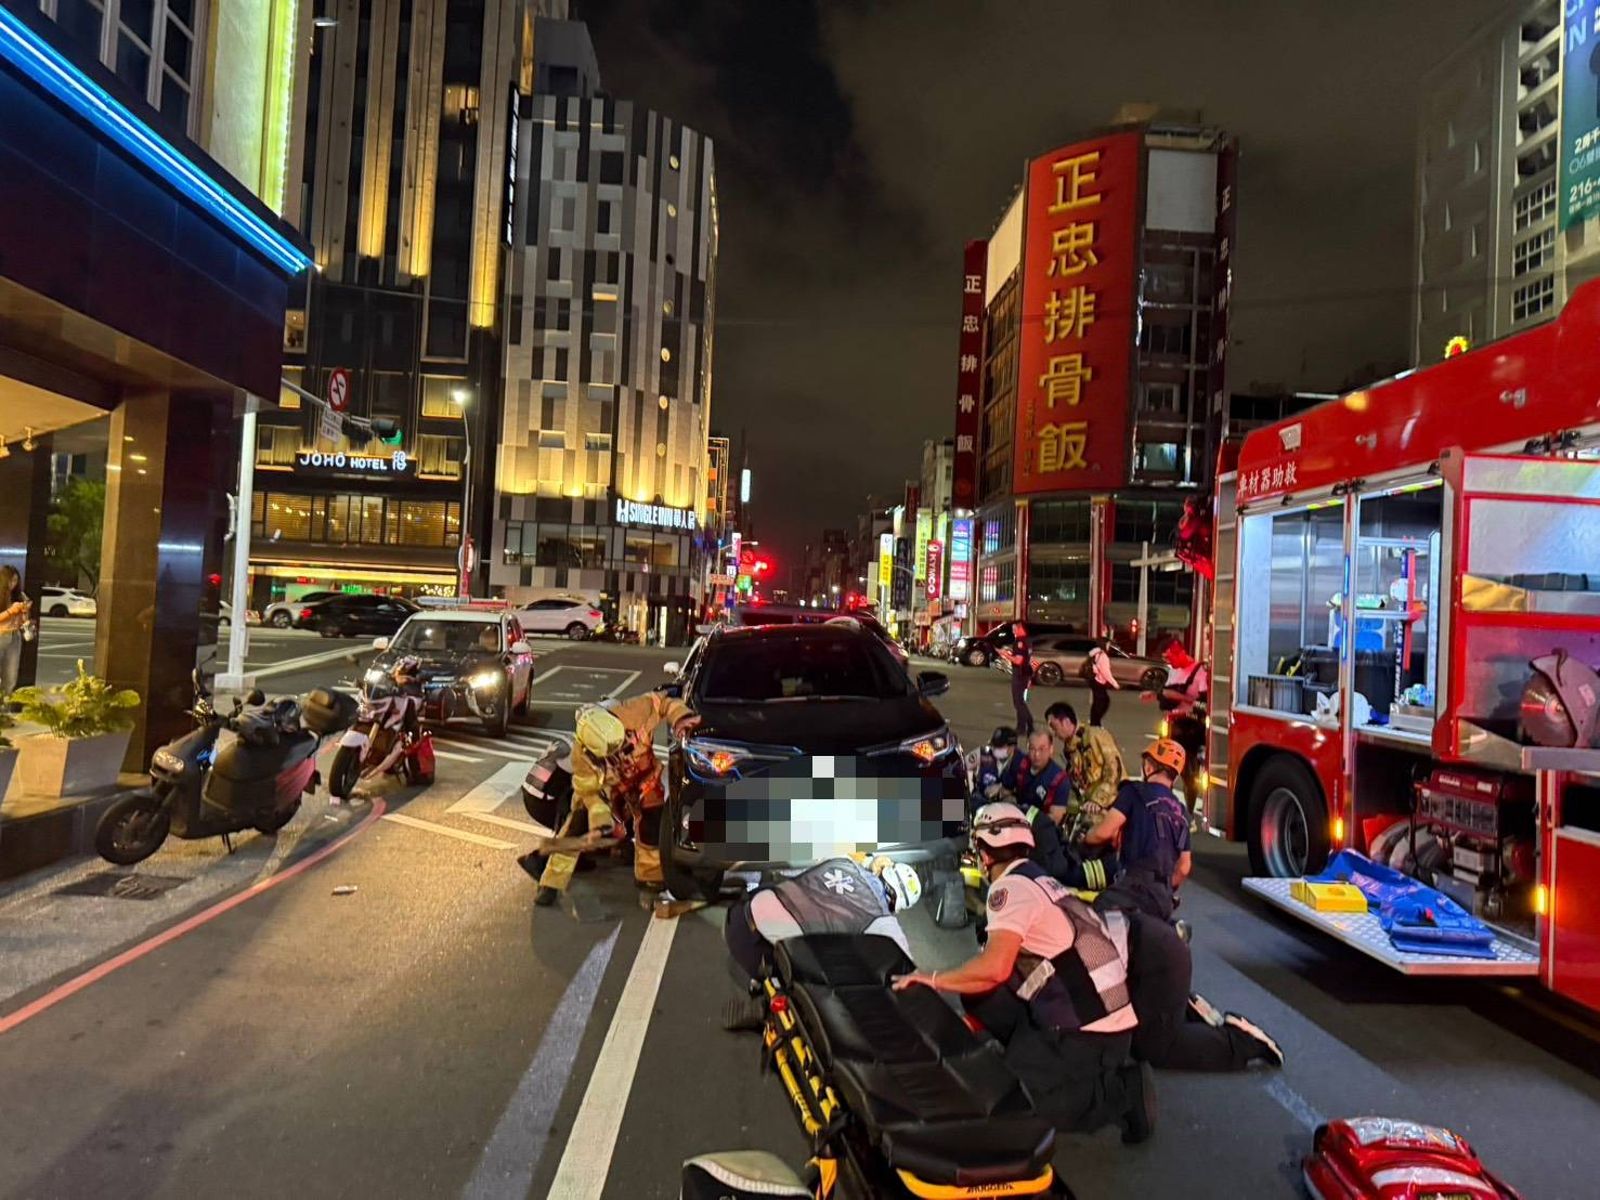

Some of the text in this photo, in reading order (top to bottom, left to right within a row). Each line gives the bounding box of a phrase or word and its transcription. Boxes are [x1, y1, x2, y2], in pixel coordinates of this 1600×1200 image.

[957, 274, 981, 453] 正忠排骨飯
[1038, 151, 1101, 474] 正忠排骨飯
[350, 457, 388, 471] HOTEL
